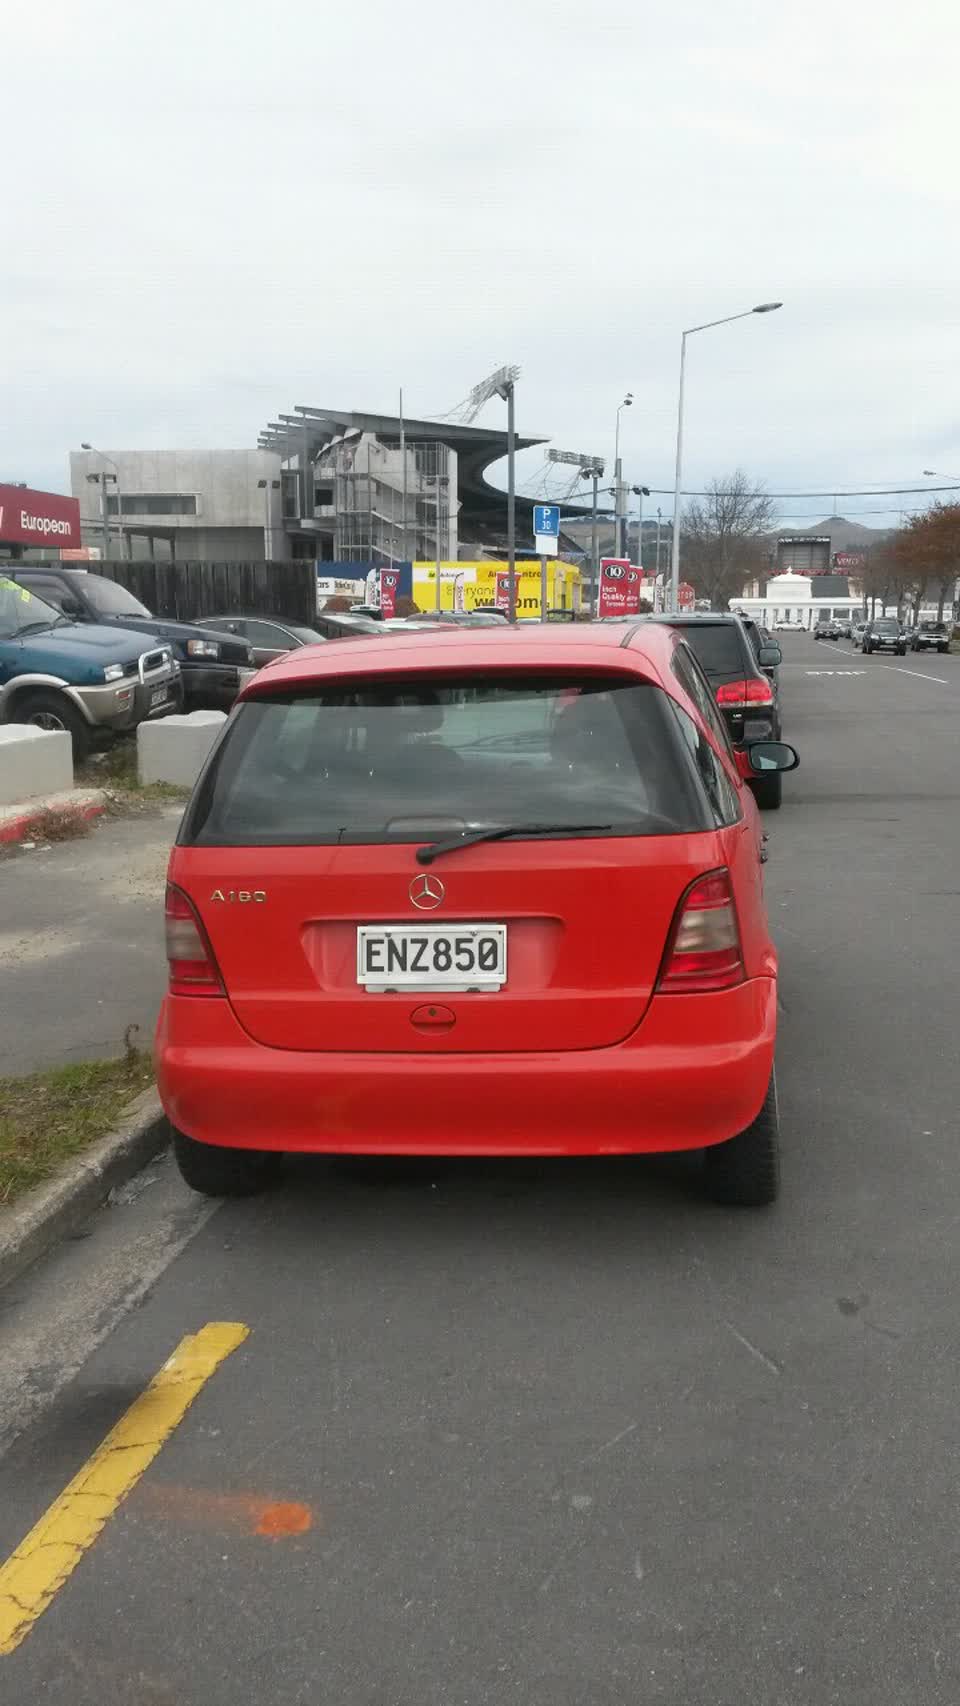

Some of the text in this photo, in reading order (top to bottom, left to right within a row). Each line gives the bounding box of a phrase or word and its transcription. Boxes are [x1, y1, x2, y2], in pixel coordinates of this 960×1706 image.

[543, 508, 551, 519] P
[21, 510, 72, 536] European
[446, 585, 497, 599] Eryone
[211, 889, 267, 902] A160
[366, 937, 498, 972] ENZ850
